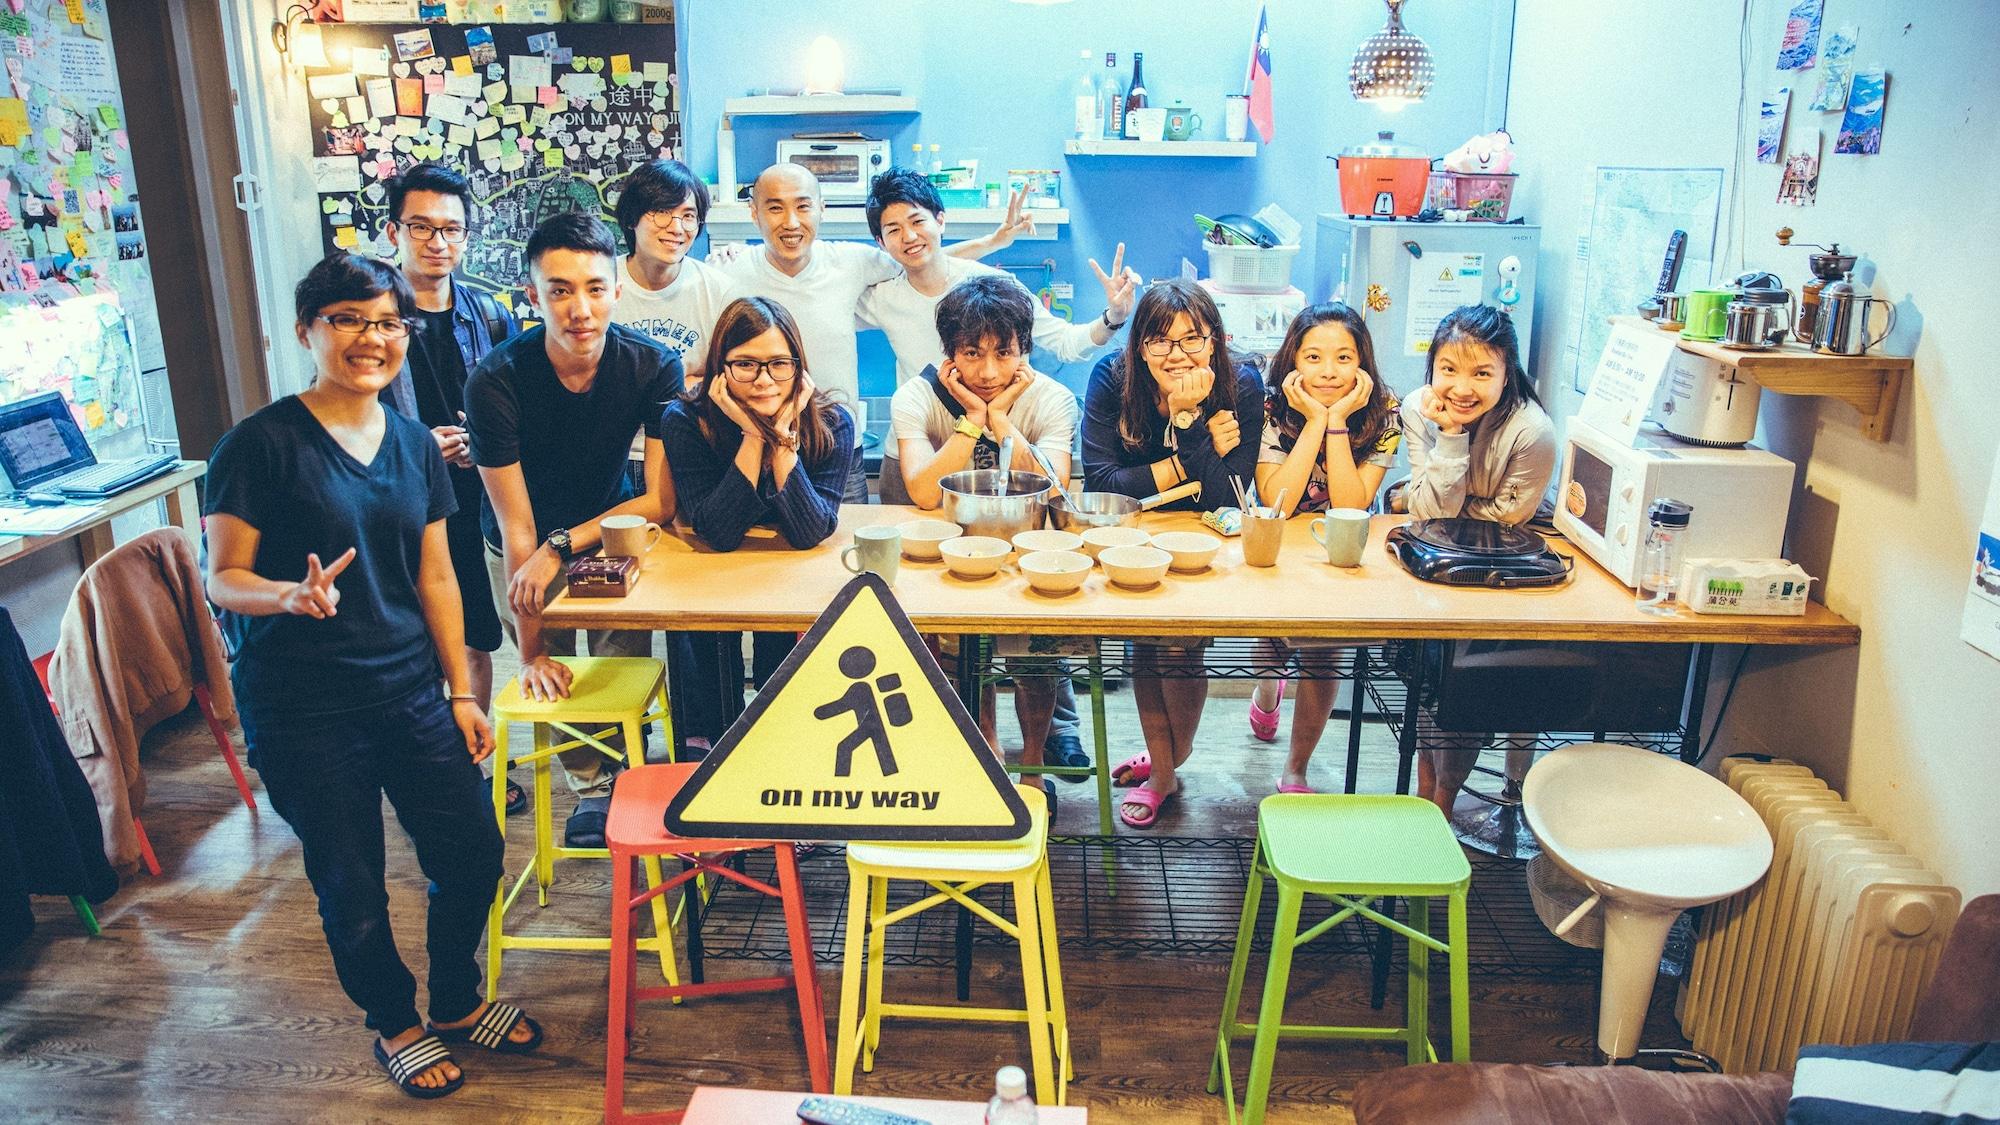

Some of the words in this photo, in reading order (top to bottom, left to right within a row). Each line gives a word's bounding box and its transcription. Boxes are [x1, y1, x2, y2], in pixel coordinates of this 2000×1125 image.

[645, 8, 672, 21] 2000g
[608, 85, 653, 107] 途中
[564, 112, 585, 126] ON
[590, 112, 614, 126] MY
[616, 112, 654, 126] WAY
[760, 788, 803, 807] on
[811, 789, 864, 810] my
[871, 790, 940, 811] way
